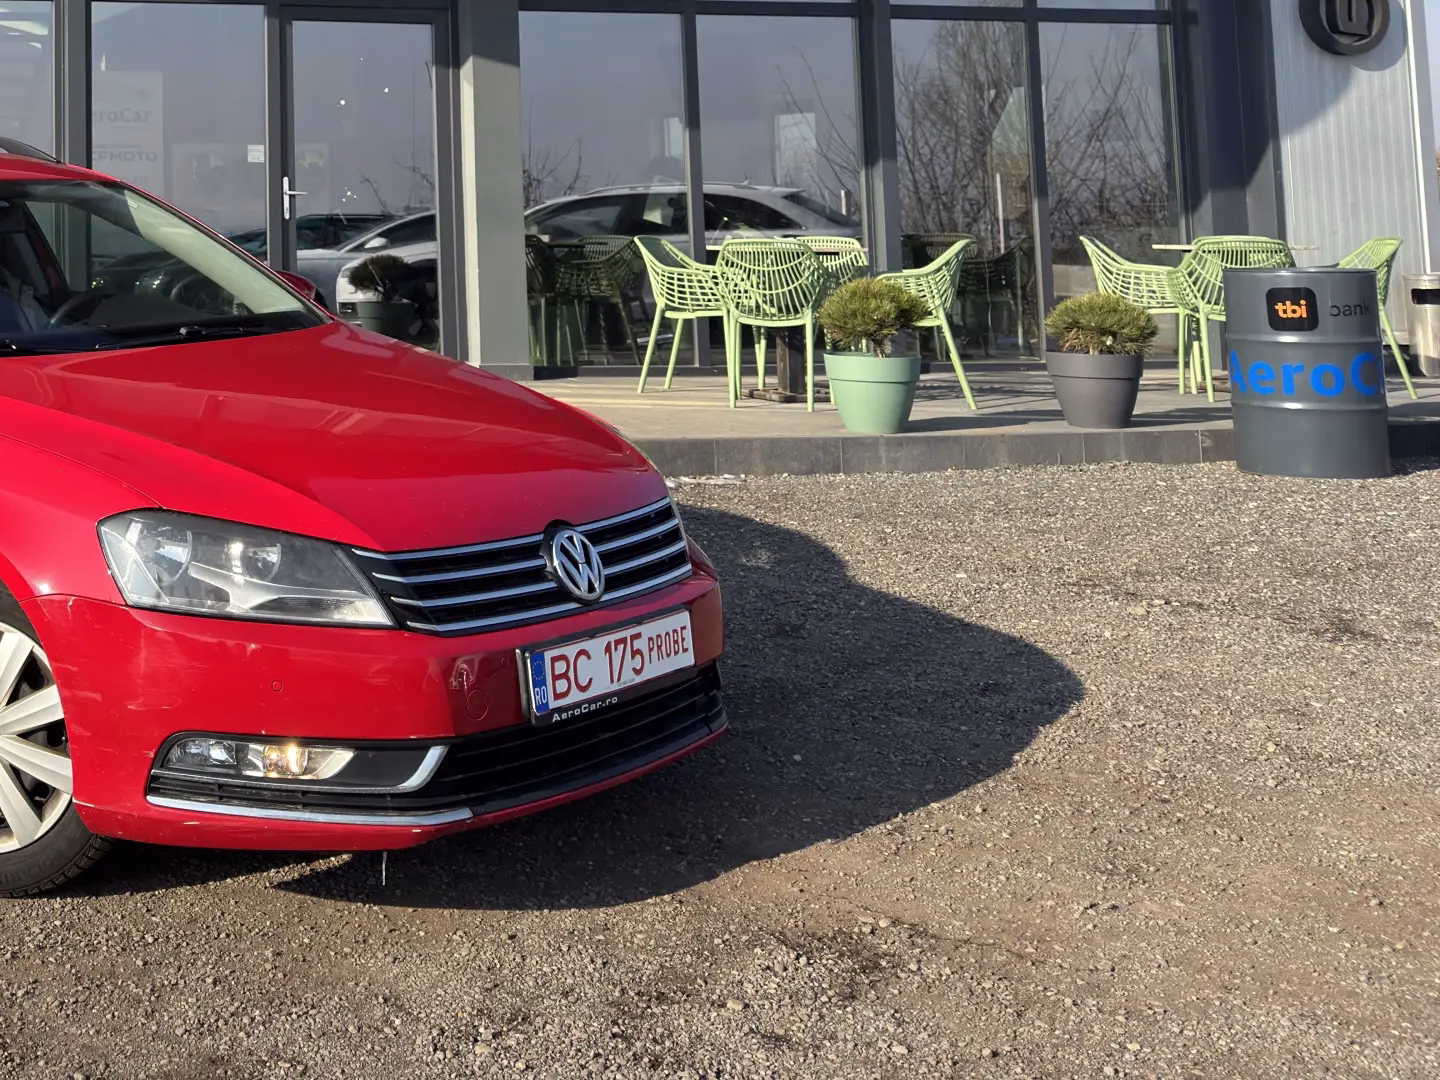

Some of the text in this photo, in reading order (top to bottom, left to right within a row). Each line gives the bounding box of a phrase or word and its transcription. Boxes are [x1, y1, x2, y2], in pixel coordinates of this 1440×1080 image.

[93, 108, 152, 123] roCar
[1274, 299, 1307, 319] tbi
[1229, 350, 1381, 398] AeroC
[550, 625, 689, 701] BC 175 PROBE
[535, 685, 547, 705] RO
[552, 696, 618, 723] AeroCar.ro
